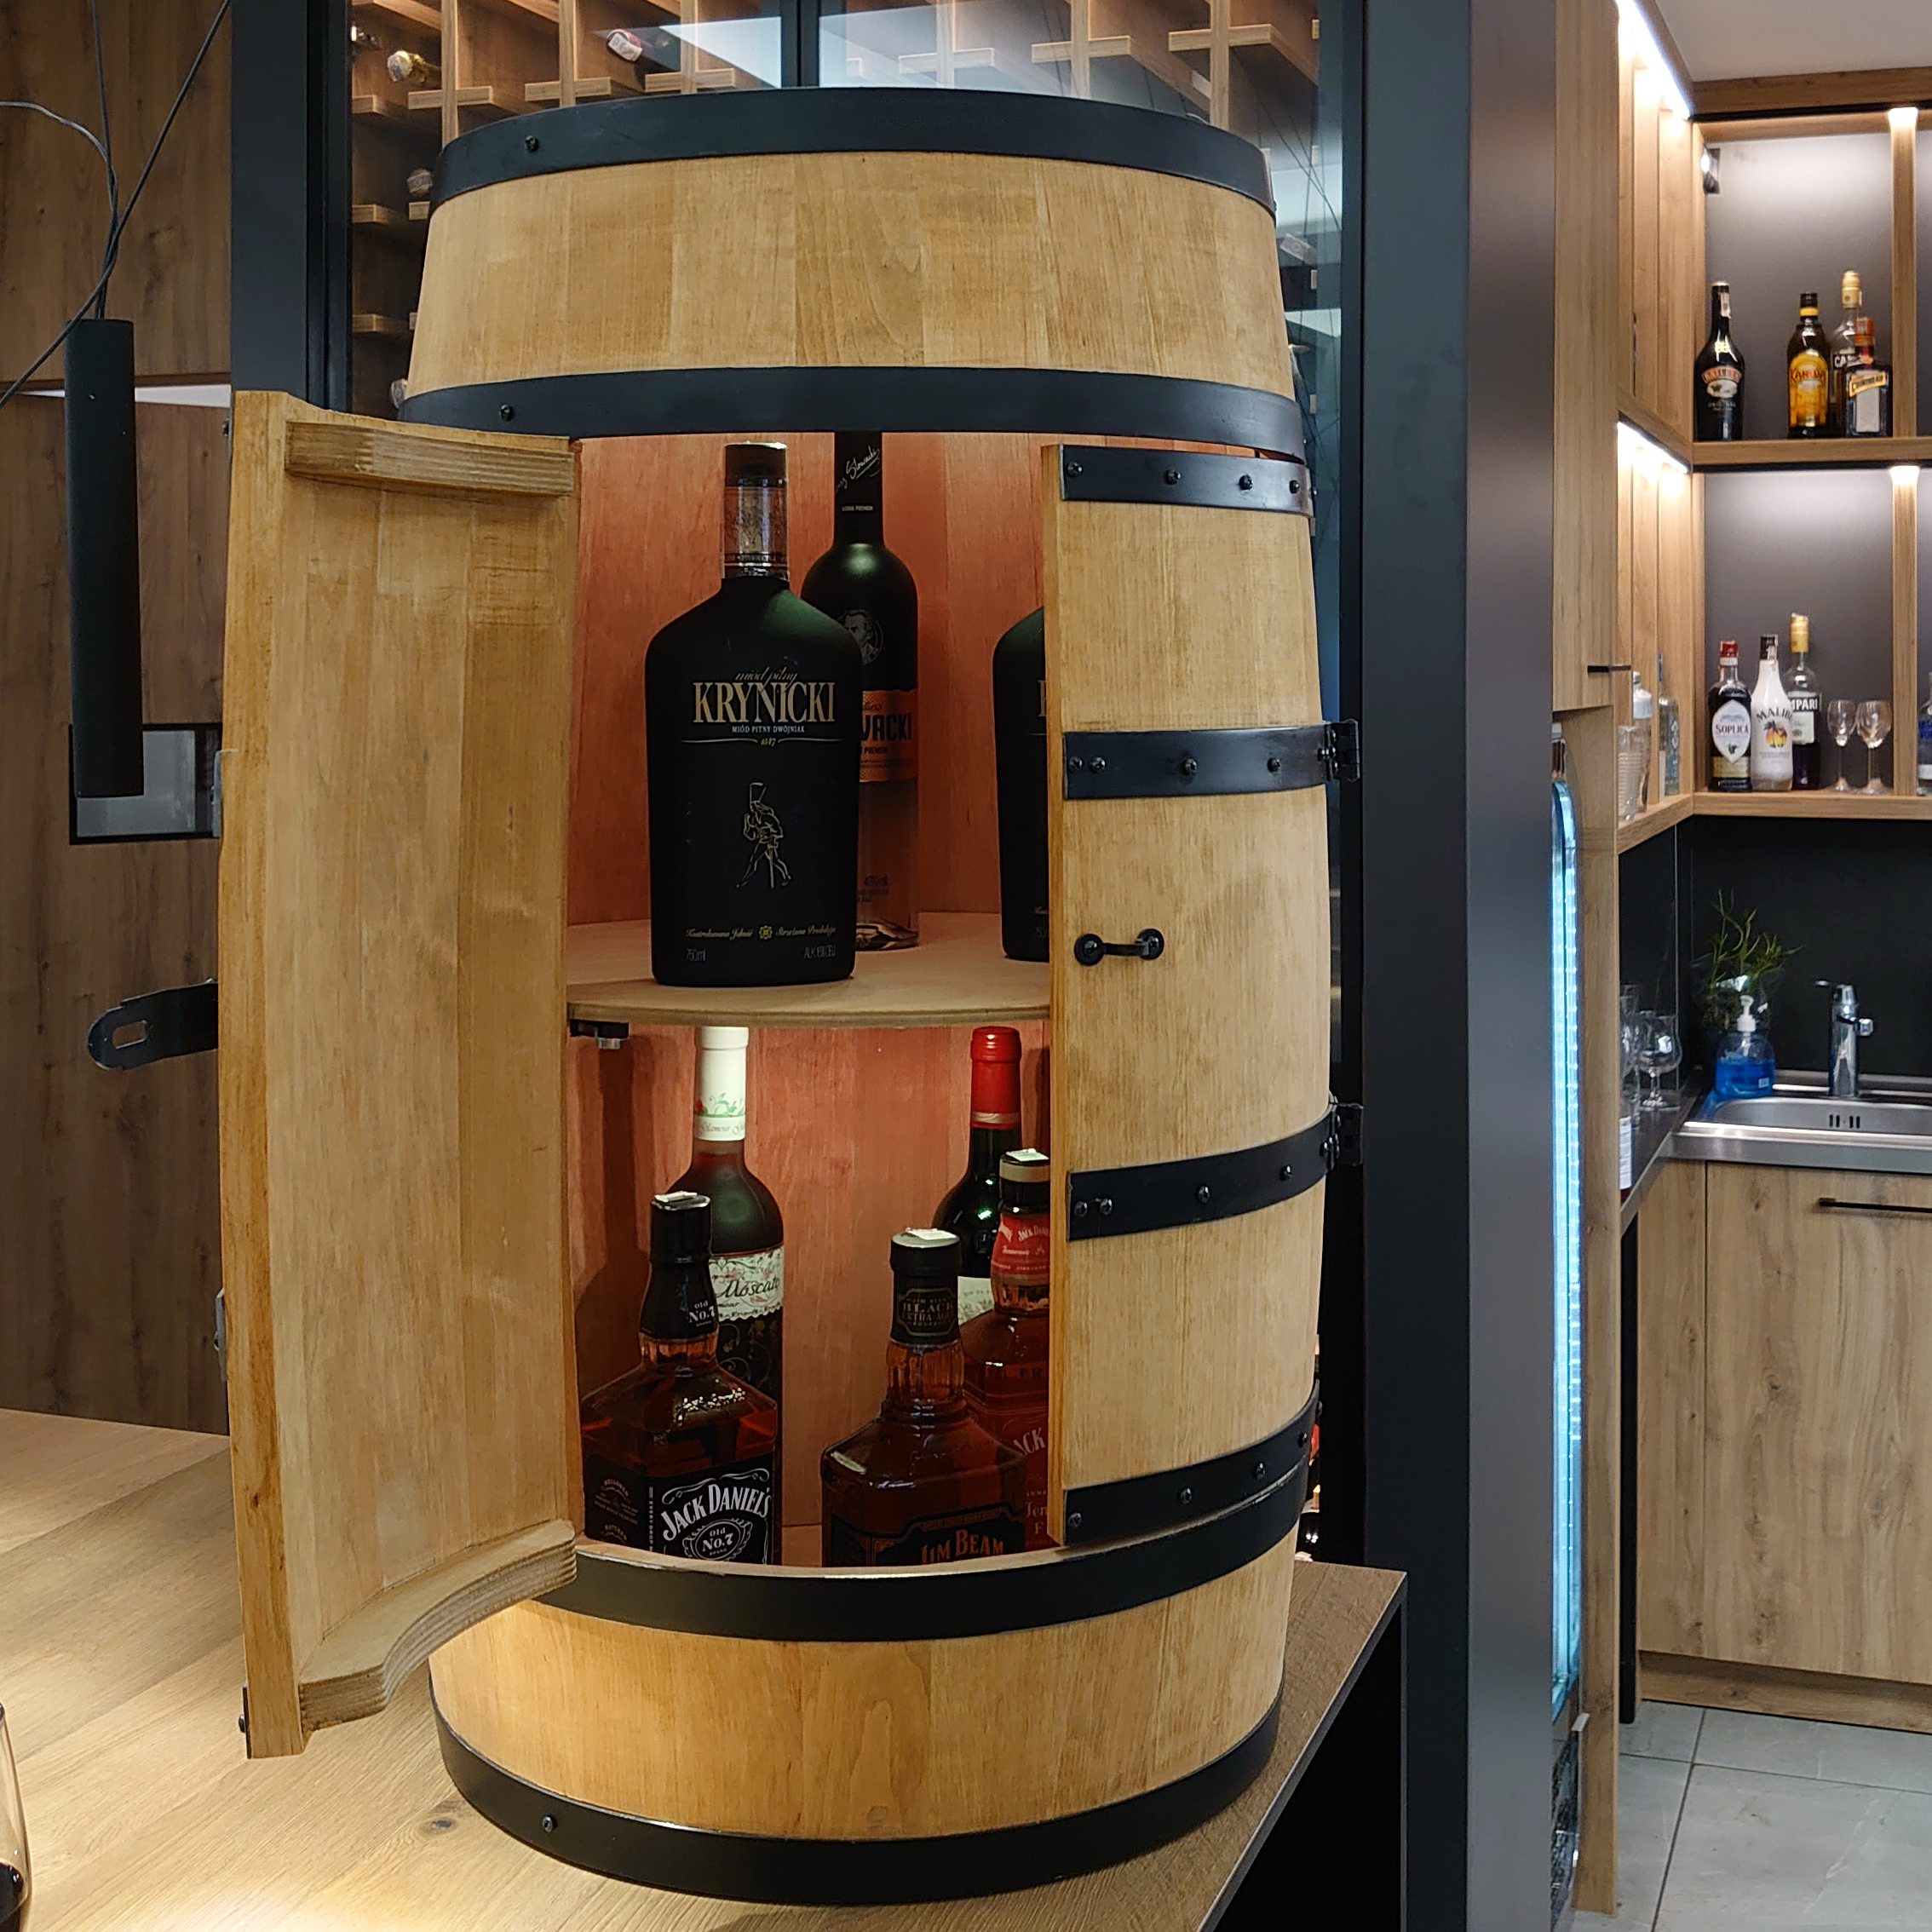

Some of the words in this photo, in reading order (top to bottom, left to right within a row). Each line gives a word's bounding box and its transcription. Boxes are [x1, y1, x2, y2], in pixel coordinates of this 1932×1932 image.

[693, 681, 836, 723] KRYNICKI
[1791, 698, 1819, 710] MPARI
[716, 1275, 780, 1297] Moscato
[660, 1494, 707, 1541] JACK
[708, 1483, 772, 1518] DANIEL'S
[702, 1532, 733, 1552] No.7
[709, 1527, 726, 1537] Old
[955, 1529, 1004, 1557] BEAM
